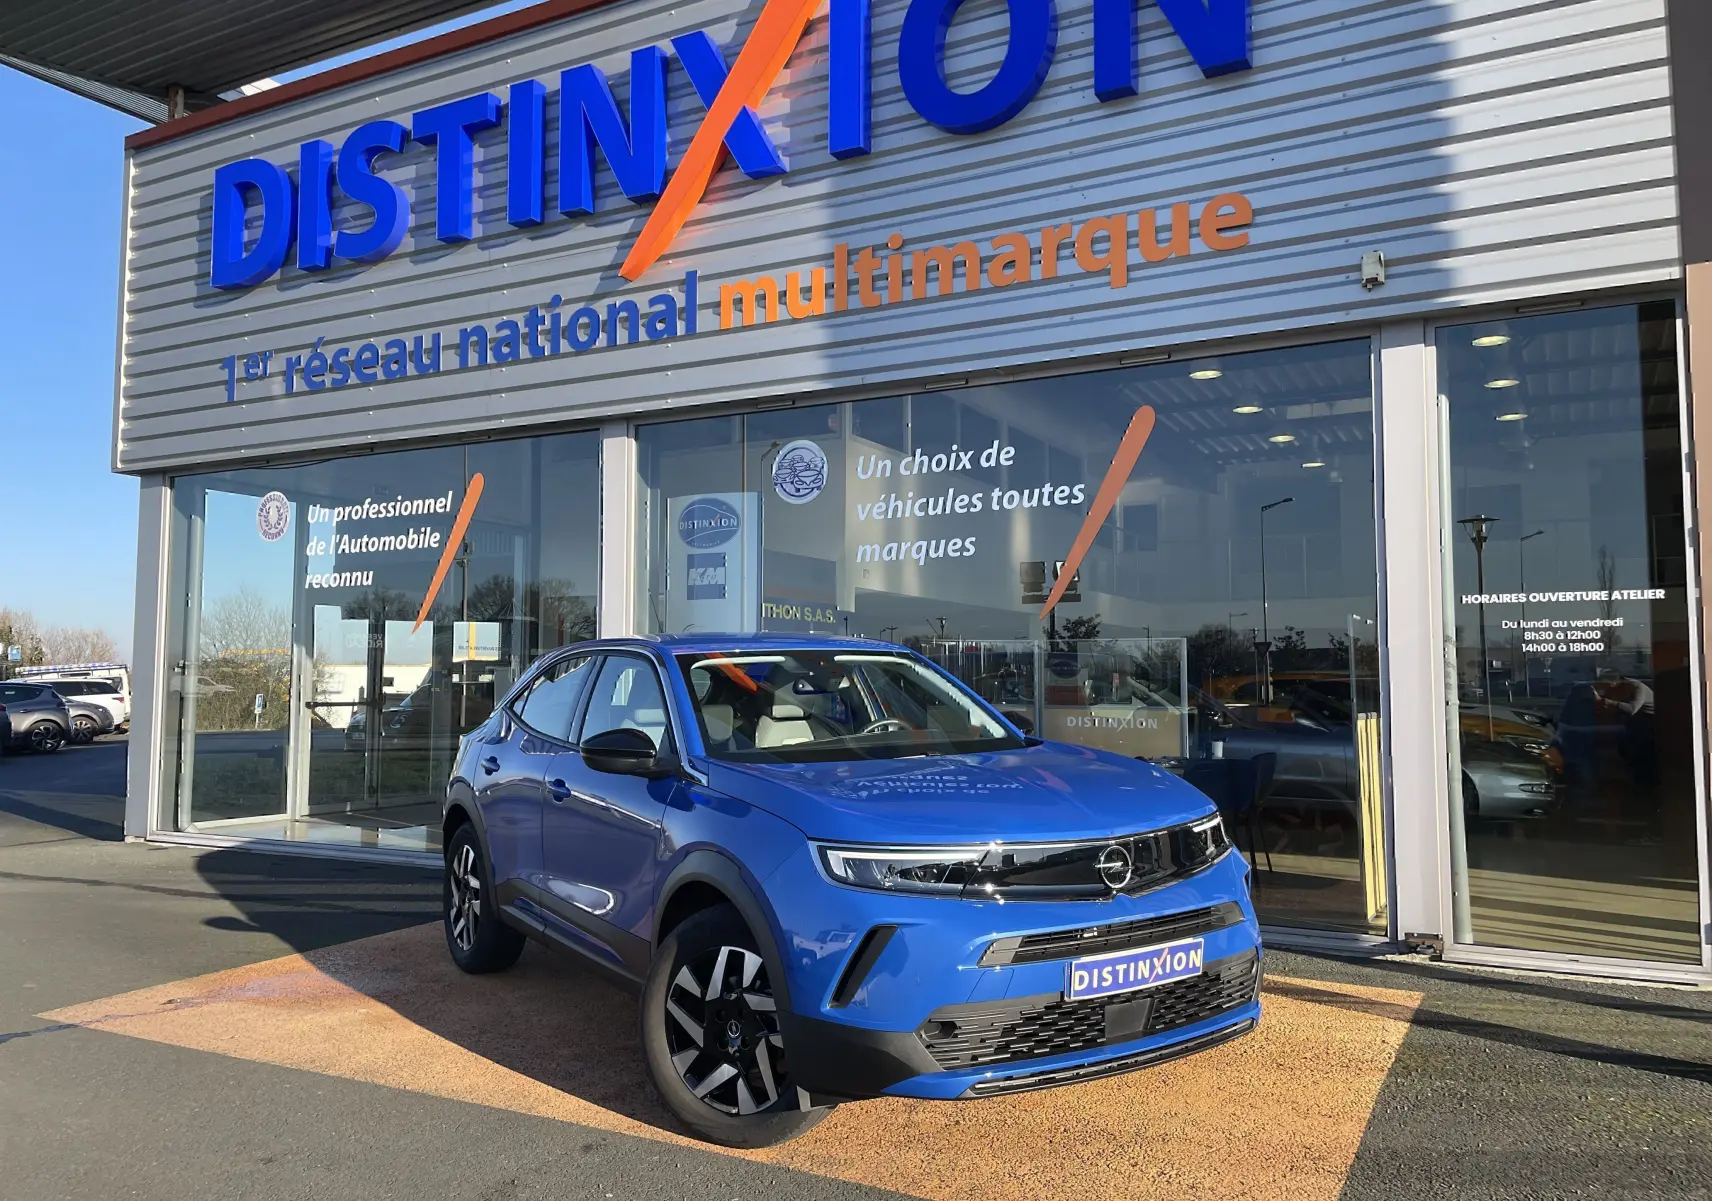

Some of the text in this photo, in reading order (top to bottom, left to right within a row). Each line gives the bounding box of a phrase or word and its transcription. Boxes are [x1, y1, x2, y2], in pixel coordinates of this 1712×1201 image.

[221, 192, 1253, 402] 1er réseau national multimarque
[857, 439, 1016, 480] Un choix de
[307, 490, 453, 526] Un professionnel
[857, 482, 1086, 521] véhicules toutes
[679, 514, 738, 530] DISTINXION
[306, 526, 440, 556] de l'Automobile
[856, 536, 976, 565] marques
[305, 570, 374, 588] reconnu
[1462, 588, 1665, 604] HORAIRES OUVERTURE ATELIER
[803, 609, 836, 624] S.A.S.
[1502, 617, 1623, 629] Du lundi au vendredi
[1524, 630, 1601, 640] 8h30 à 12h00
[1522, 641, 1604, 652] 14h00 à 18h00
[1067, 713, 1158, 731] DISTINXION
[1074, 948, 1201, 991] DISTINXION
